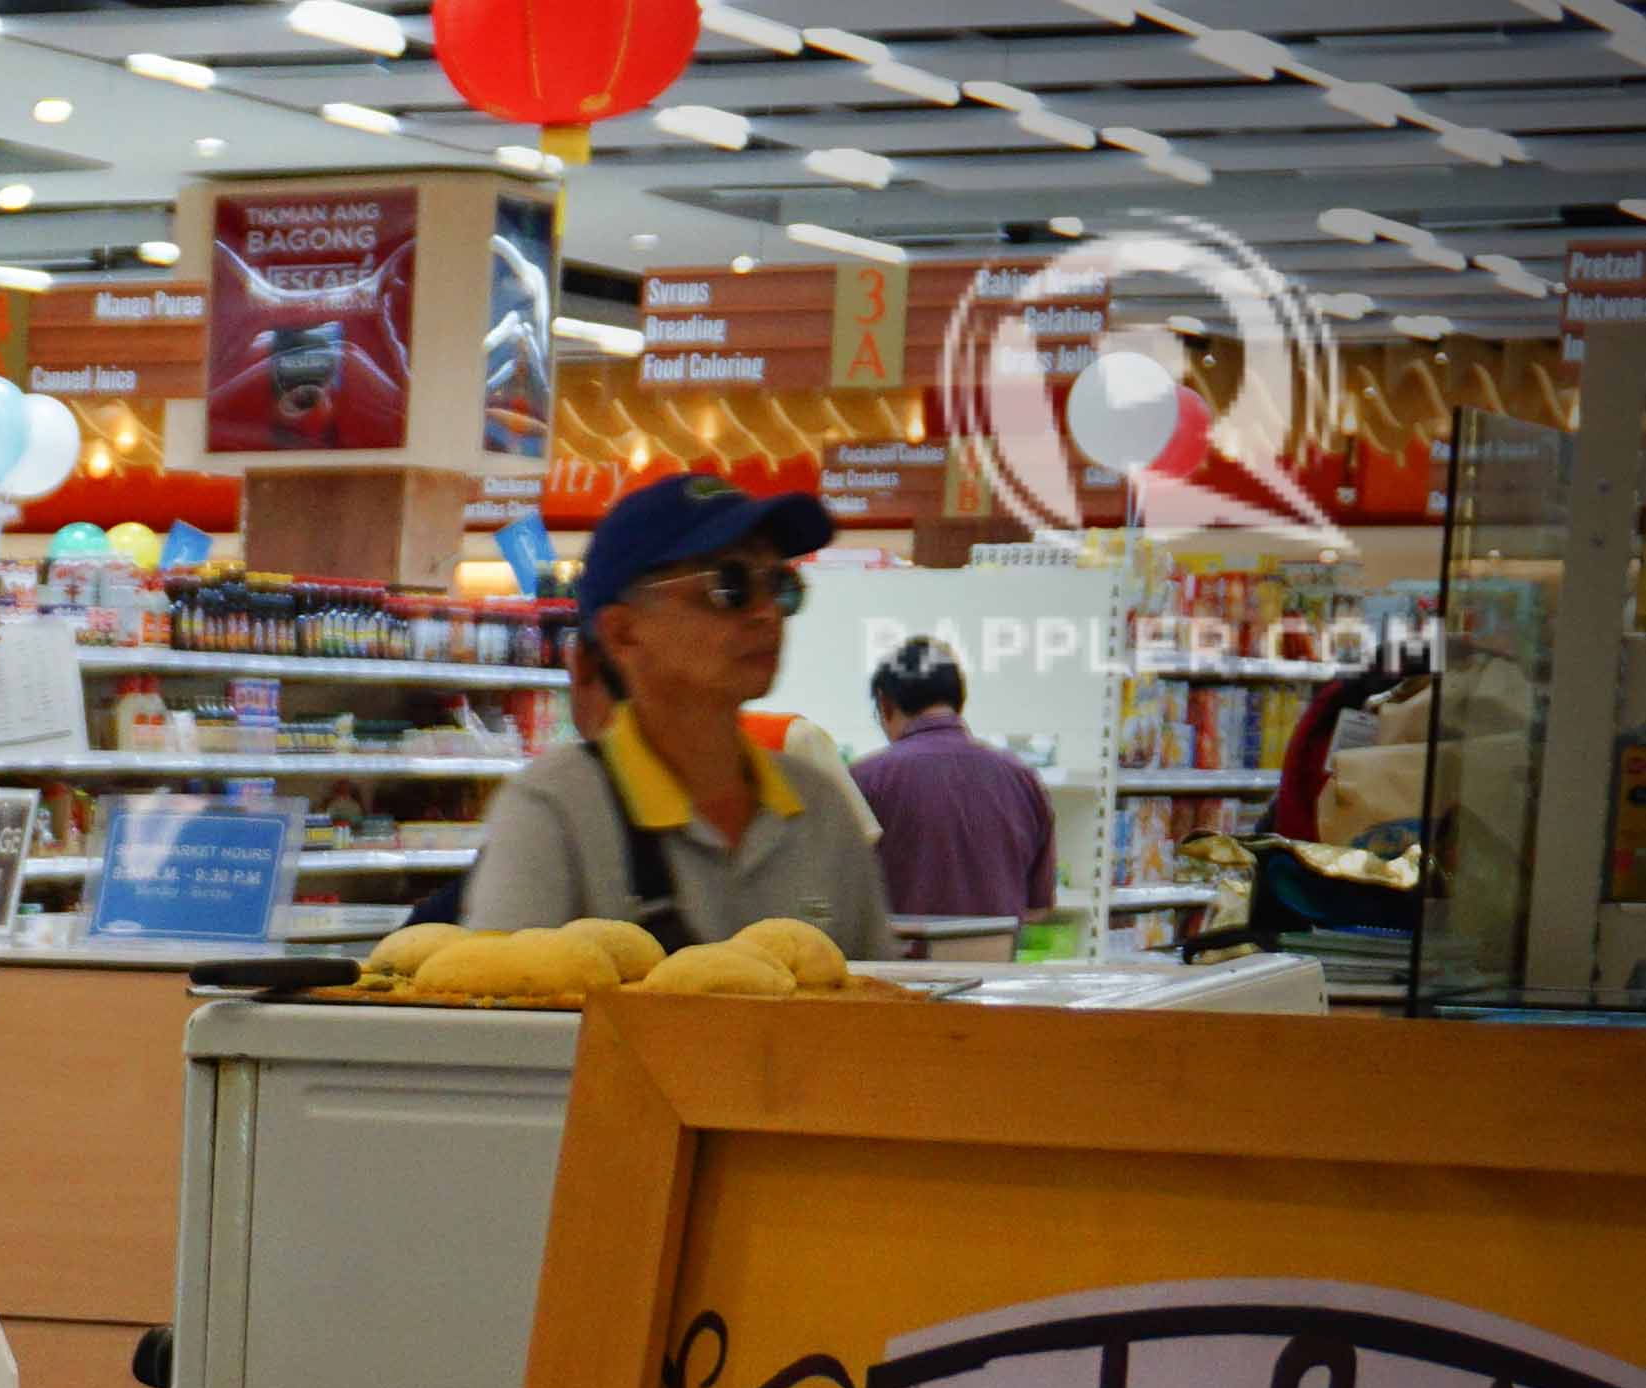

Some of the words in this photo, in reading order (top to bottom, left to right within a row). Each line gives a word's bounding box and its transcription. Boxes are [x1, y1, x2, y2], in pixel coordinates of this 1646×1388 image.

[245, 204, 327, 225] TIKMAN
[332, 202, 380, 221] ANG
[246, 226, 377, 254] BAGONG
[646, 278, 710, 307] Syrups
[855, 268, 886, 325] 3
[644, 314, 727, 344] Breading
[1023, 305, 1103, 332] Gelatine
[642, 353, 685, 381] Food
[688, 352, 765, 383] Coloring
[847, 333, 886, 380] A
